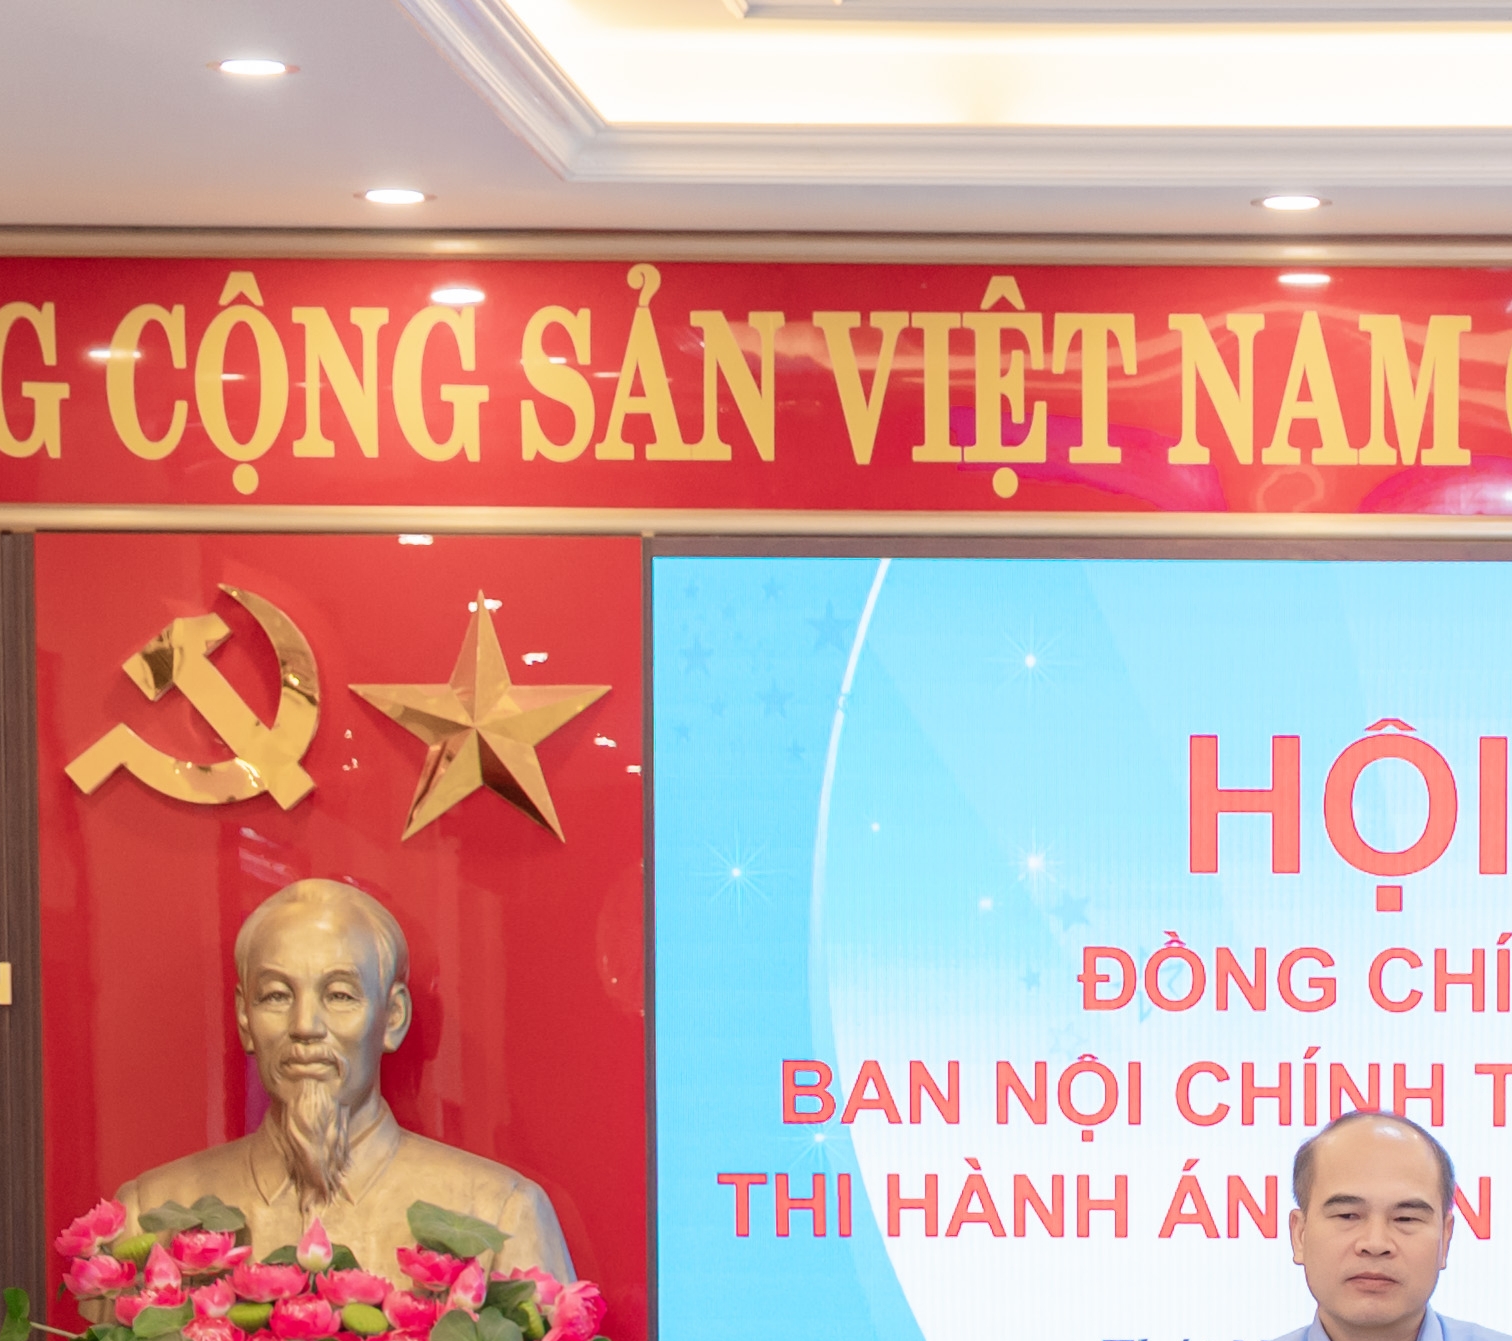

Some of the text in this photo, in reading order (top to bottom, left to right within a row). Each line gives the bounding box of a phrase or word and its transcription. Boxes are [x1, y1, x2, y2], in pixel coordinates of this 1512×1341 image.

[105, 271, 489, 495] CỘNG
[519, 263, 785, 465] SẢN
[812, 276, 1140, 499] VIỆT
[1167, 313, 1471, 468] NAM
[1189, 717, 1509, 913] HỘI
[1077, 930, 1337, 1013] ĐỒNG
[781, 1059, 961, 1125] BAN
[995, 1053, 1142, 1143] NỘI
[1175, 1045, 1445, 1128] CHÍNH
[717, 1173, 853, 1238] THI
[886, 1157, 1129, 1239] HÀNH
[1158, 1158, 1279, 1240] ÁN
